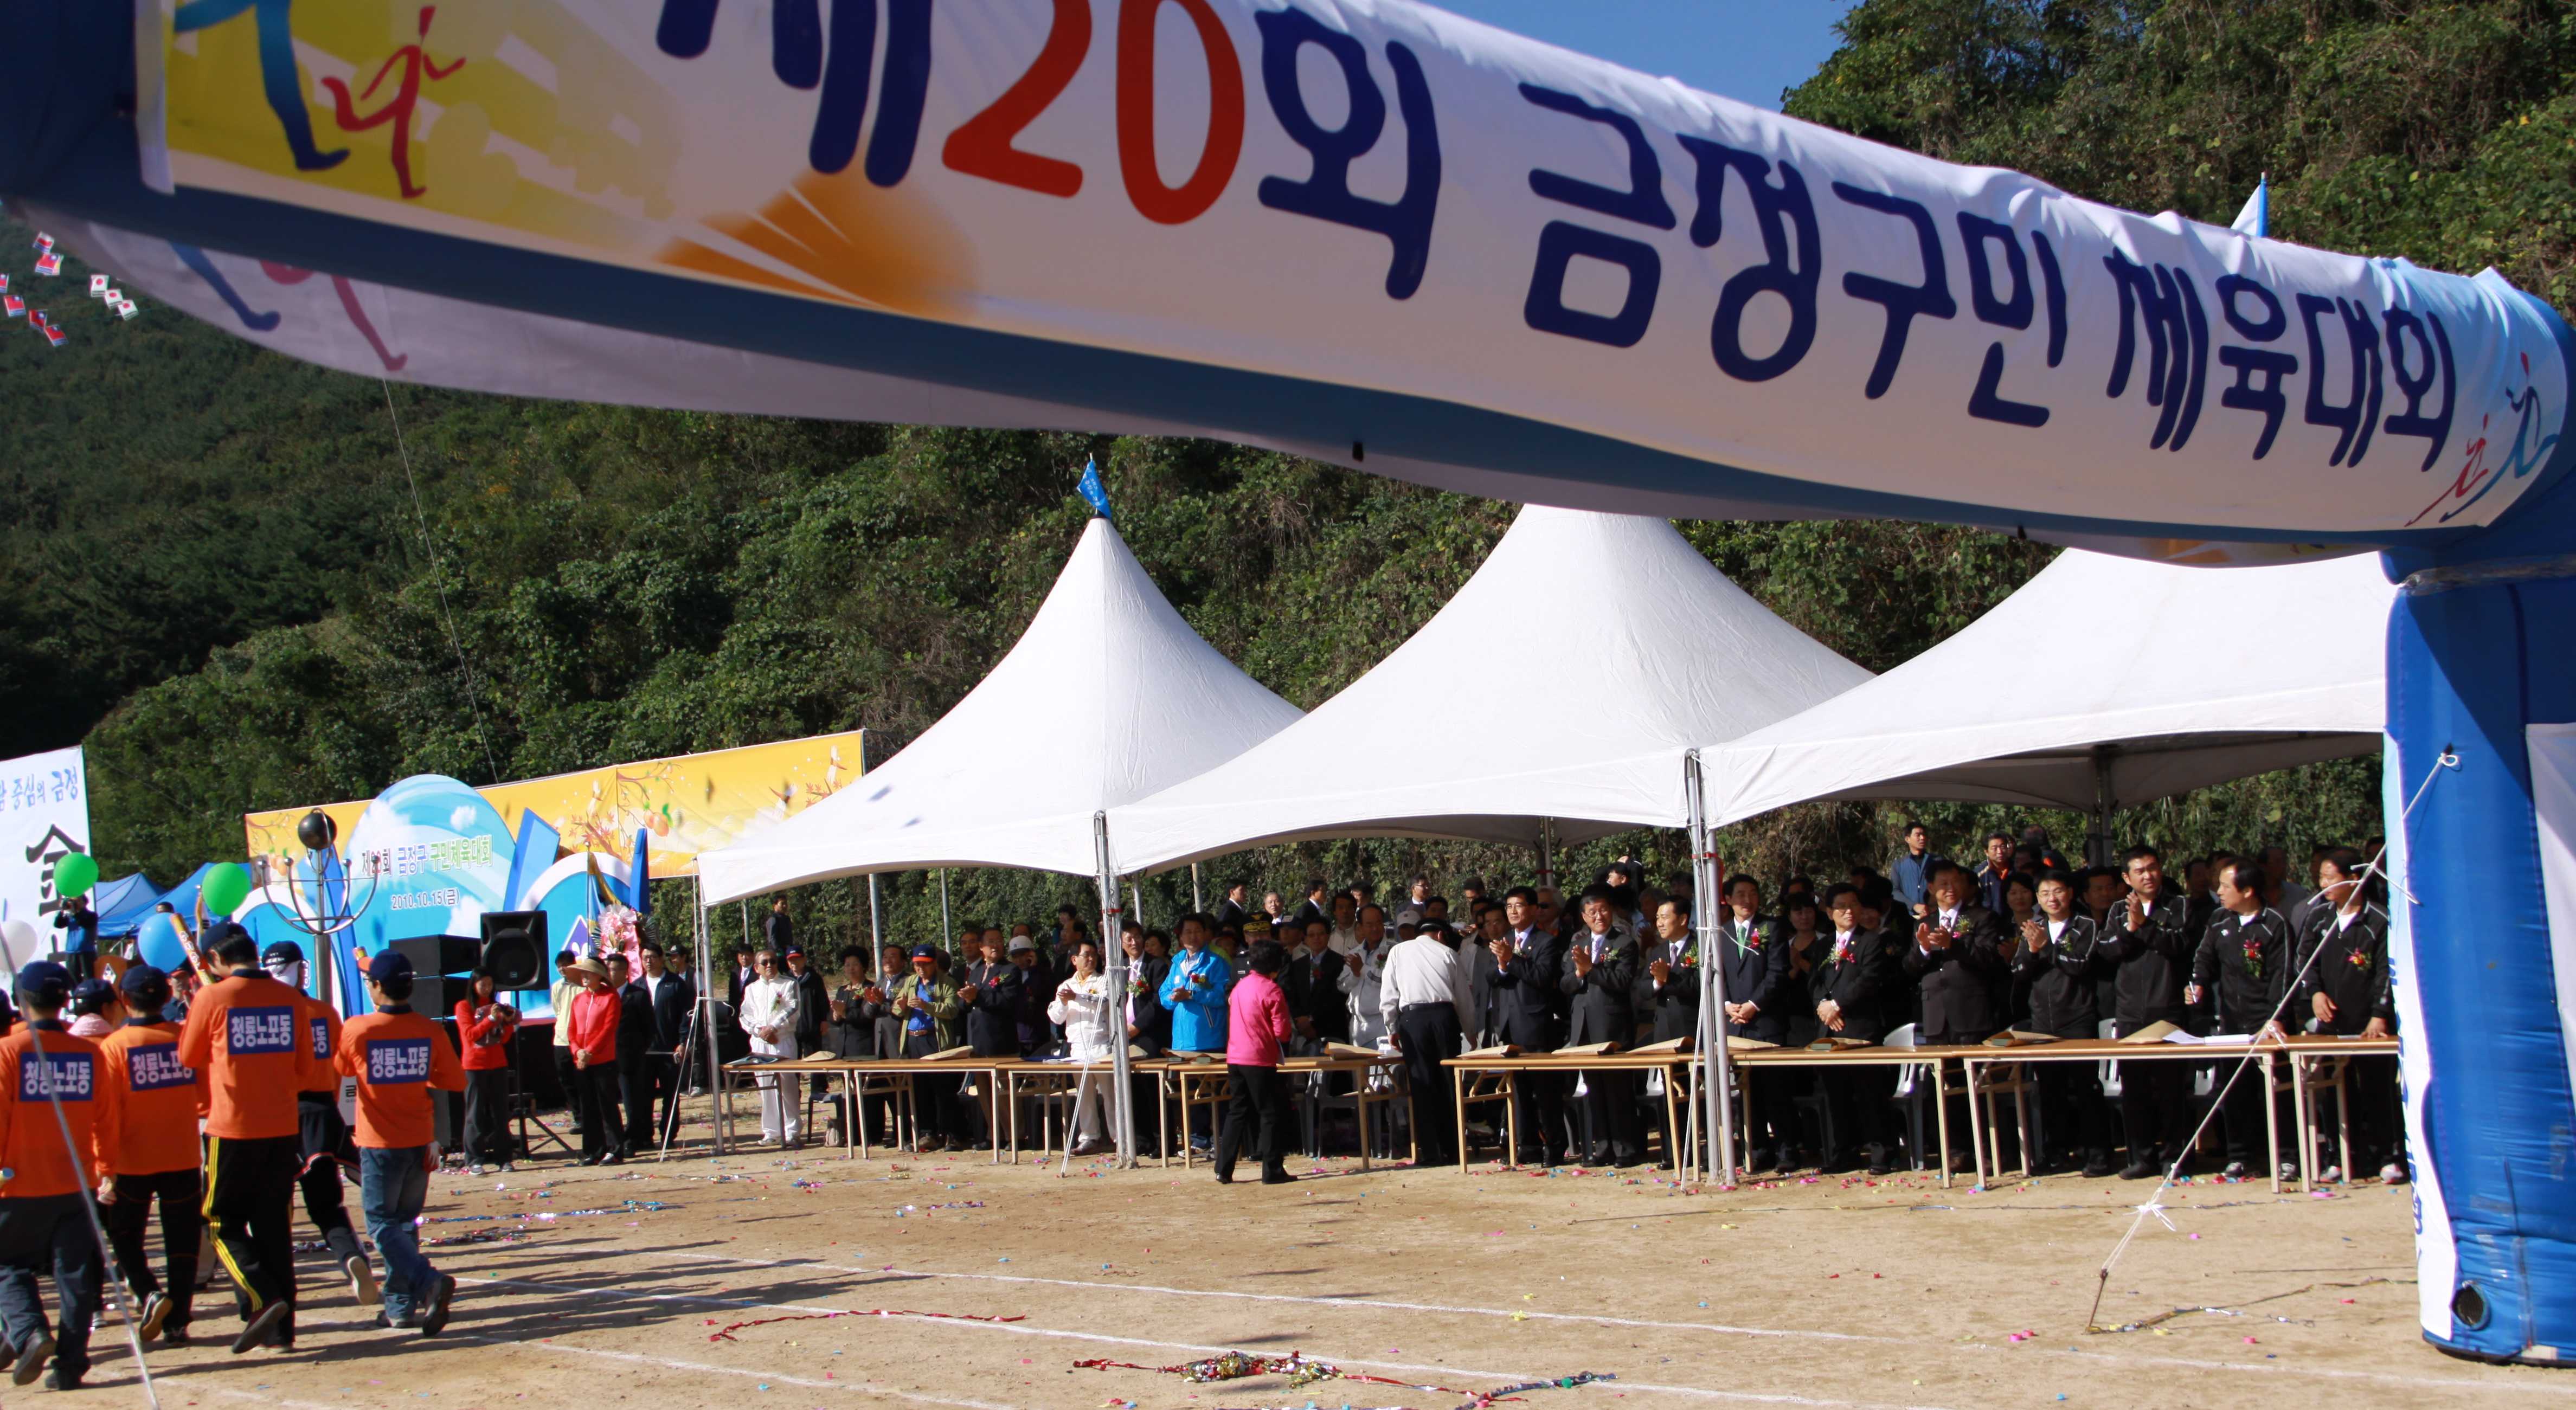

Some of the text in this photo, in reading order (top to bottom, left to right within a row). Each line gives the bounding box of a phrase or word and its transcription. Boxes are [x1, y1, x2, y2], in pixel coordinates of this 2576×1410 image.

[1519, 84, 2067, 426] 금정구민
[11, 774, 46, 810] 중심의
[52, 766, 78, 802] 금정
[398, 844, 427, 875] 금정구
[430, 835, 492, 871] 구민체육대회
[392, 888, 459, 910] 2010.10.15(금)
[232, 1014, 291, 1048] 청룡노포동
[24, 1061, 91, 1094] 청룡노포동
[371, 1046, 429, 1078] 청룡노포동
